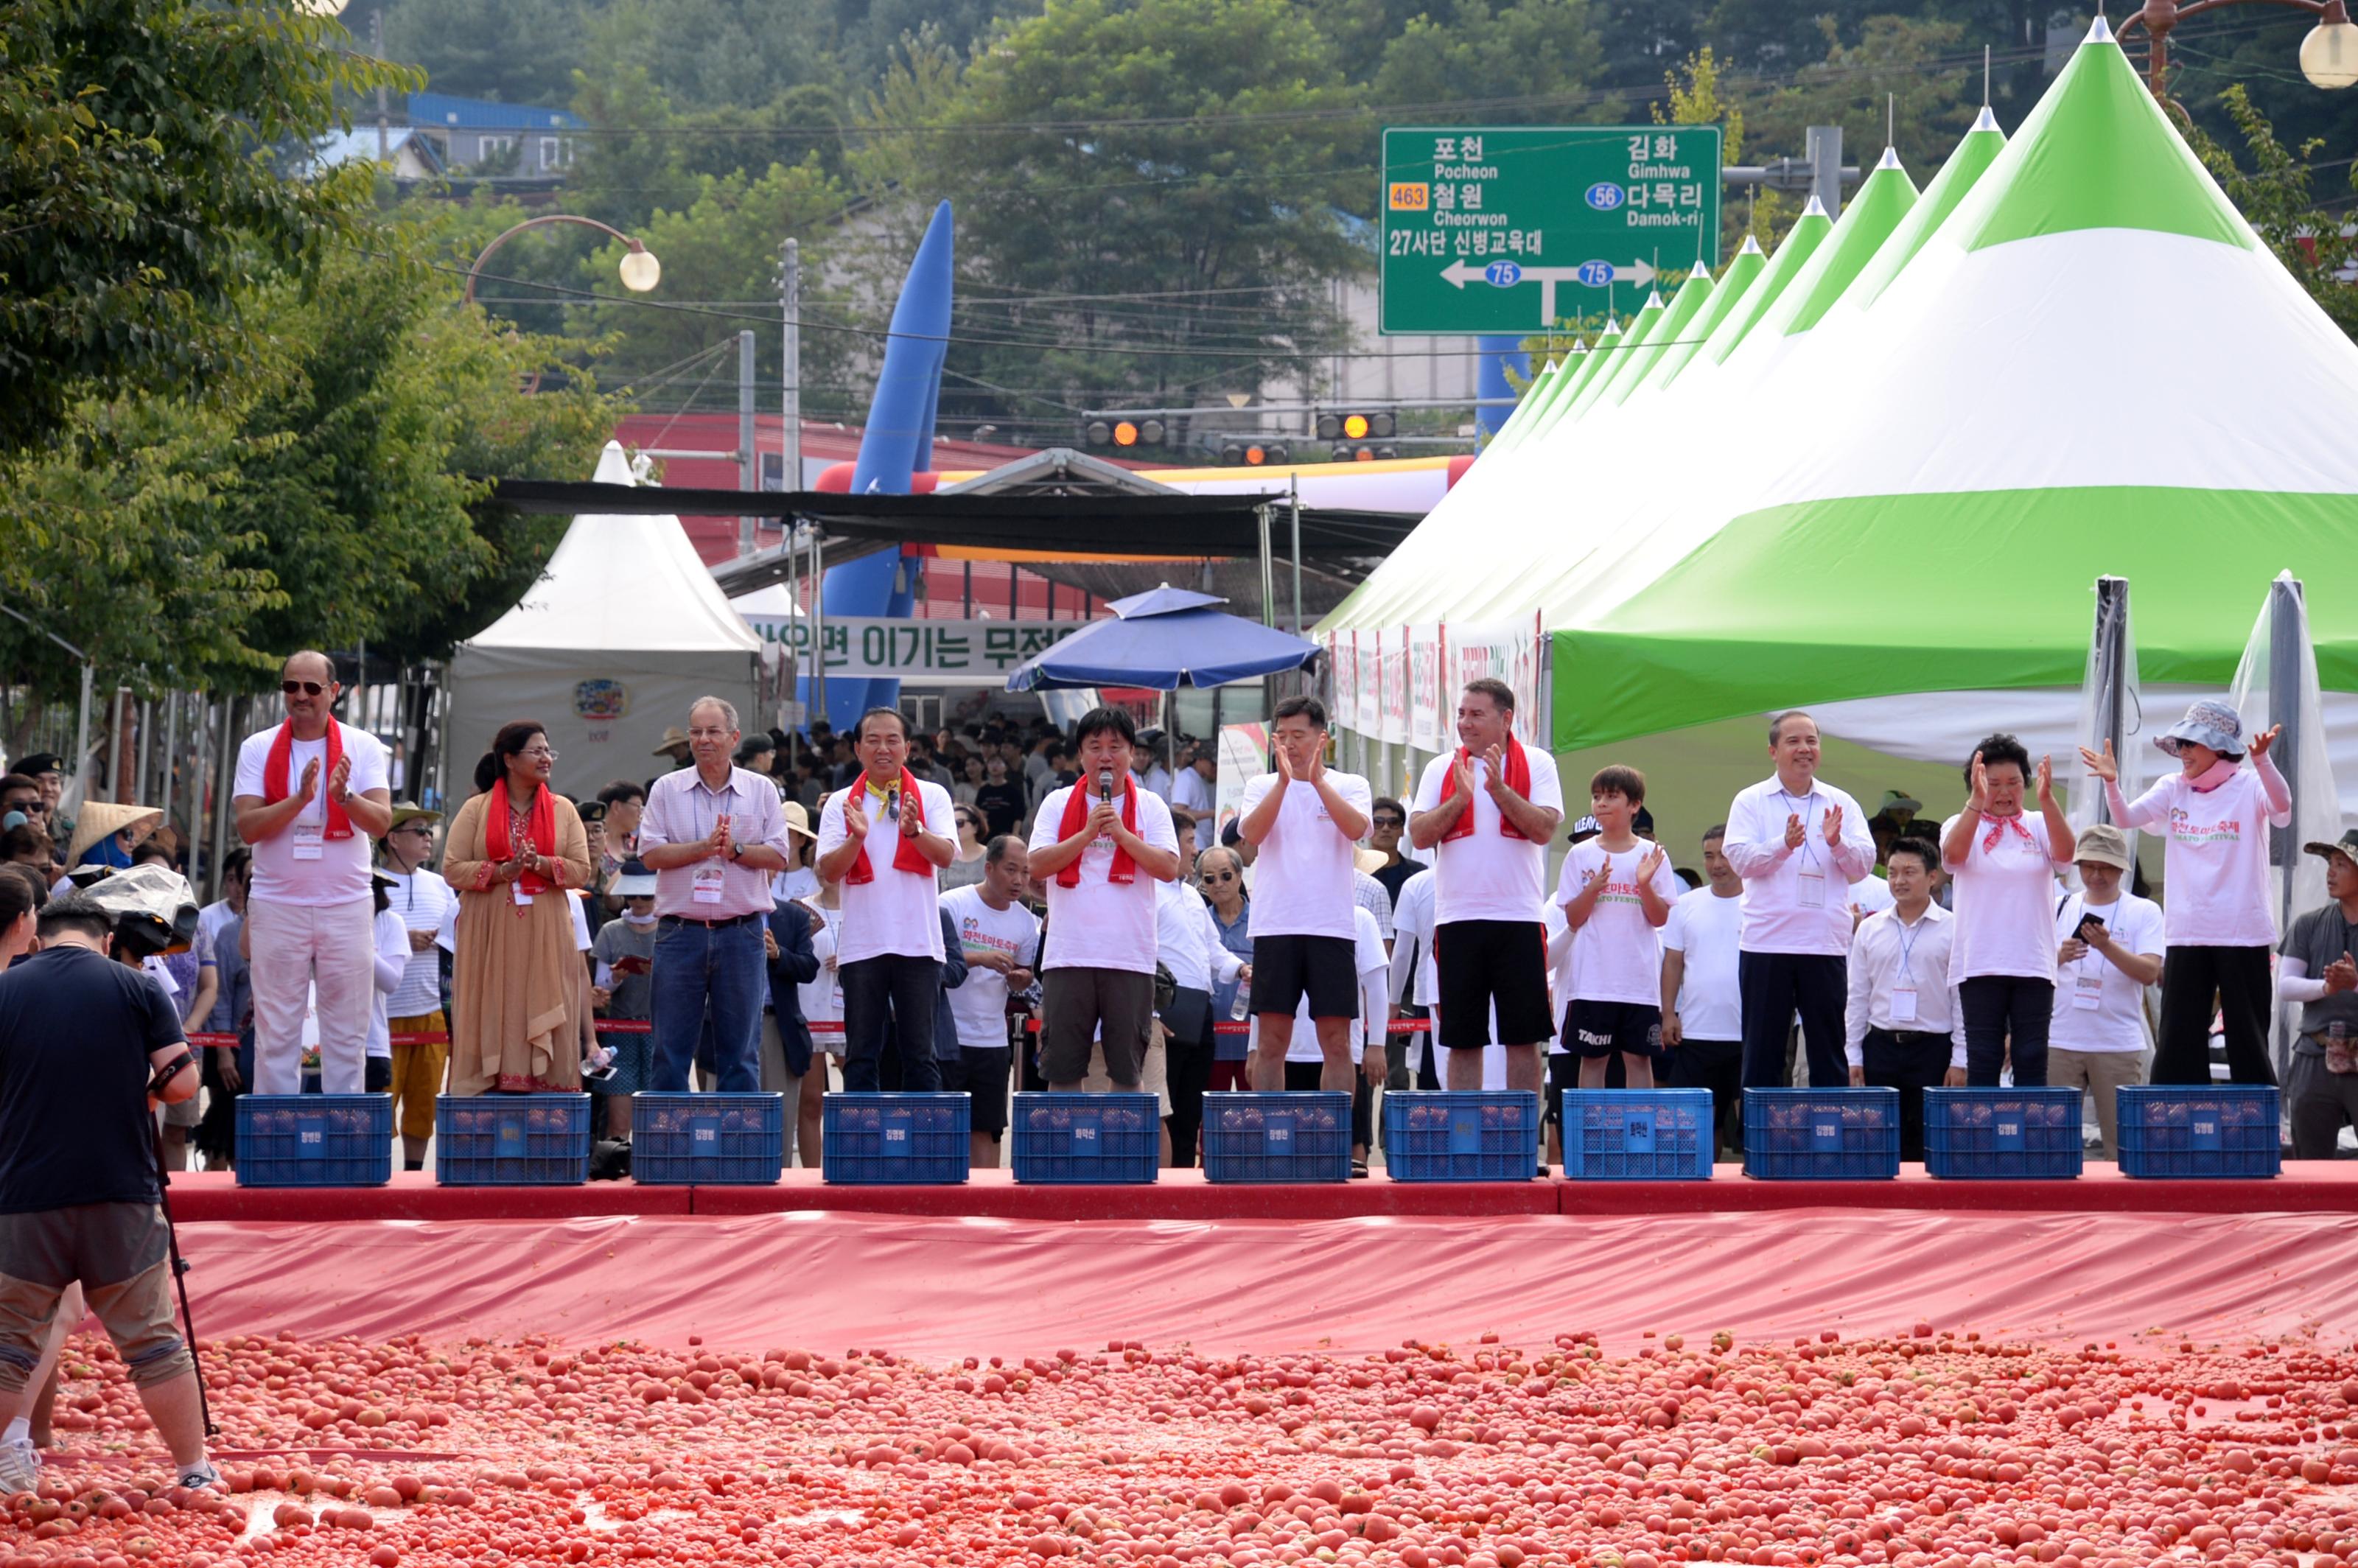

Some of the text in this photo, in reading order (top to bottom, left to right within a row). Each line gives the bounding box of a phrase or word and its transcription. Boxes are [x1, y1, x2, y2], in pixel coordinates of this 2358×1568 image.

[1432, 136, 1483, 161] 포천
[1627, 134, 1678, 161] 김화
[1434, 163, 1498, 179] Pocheon
[1628, 162, 1690, 179] Gimhwa
[1393, 188, 1424, 206] 463
[1432, 182, 1483, 209] 철원
[1595, 186, 1616, 206] 56
[1627, 182, 1702, 209] 다목리
[1433, 210, 1508, 226] Cheorwon
[1627, 210, 1698, 227] Damok-ri
[1390, 229, 1542, 256] 27사단 신병교육대
[1492, 264, 1514, 284] 75
[1586, 264, 1607, 284] 75
[863, 625, 970, 668] 이기는
[984, 626, 1077, 669] 무적
[1578, 1028, 1612, 1046] TAKHI
